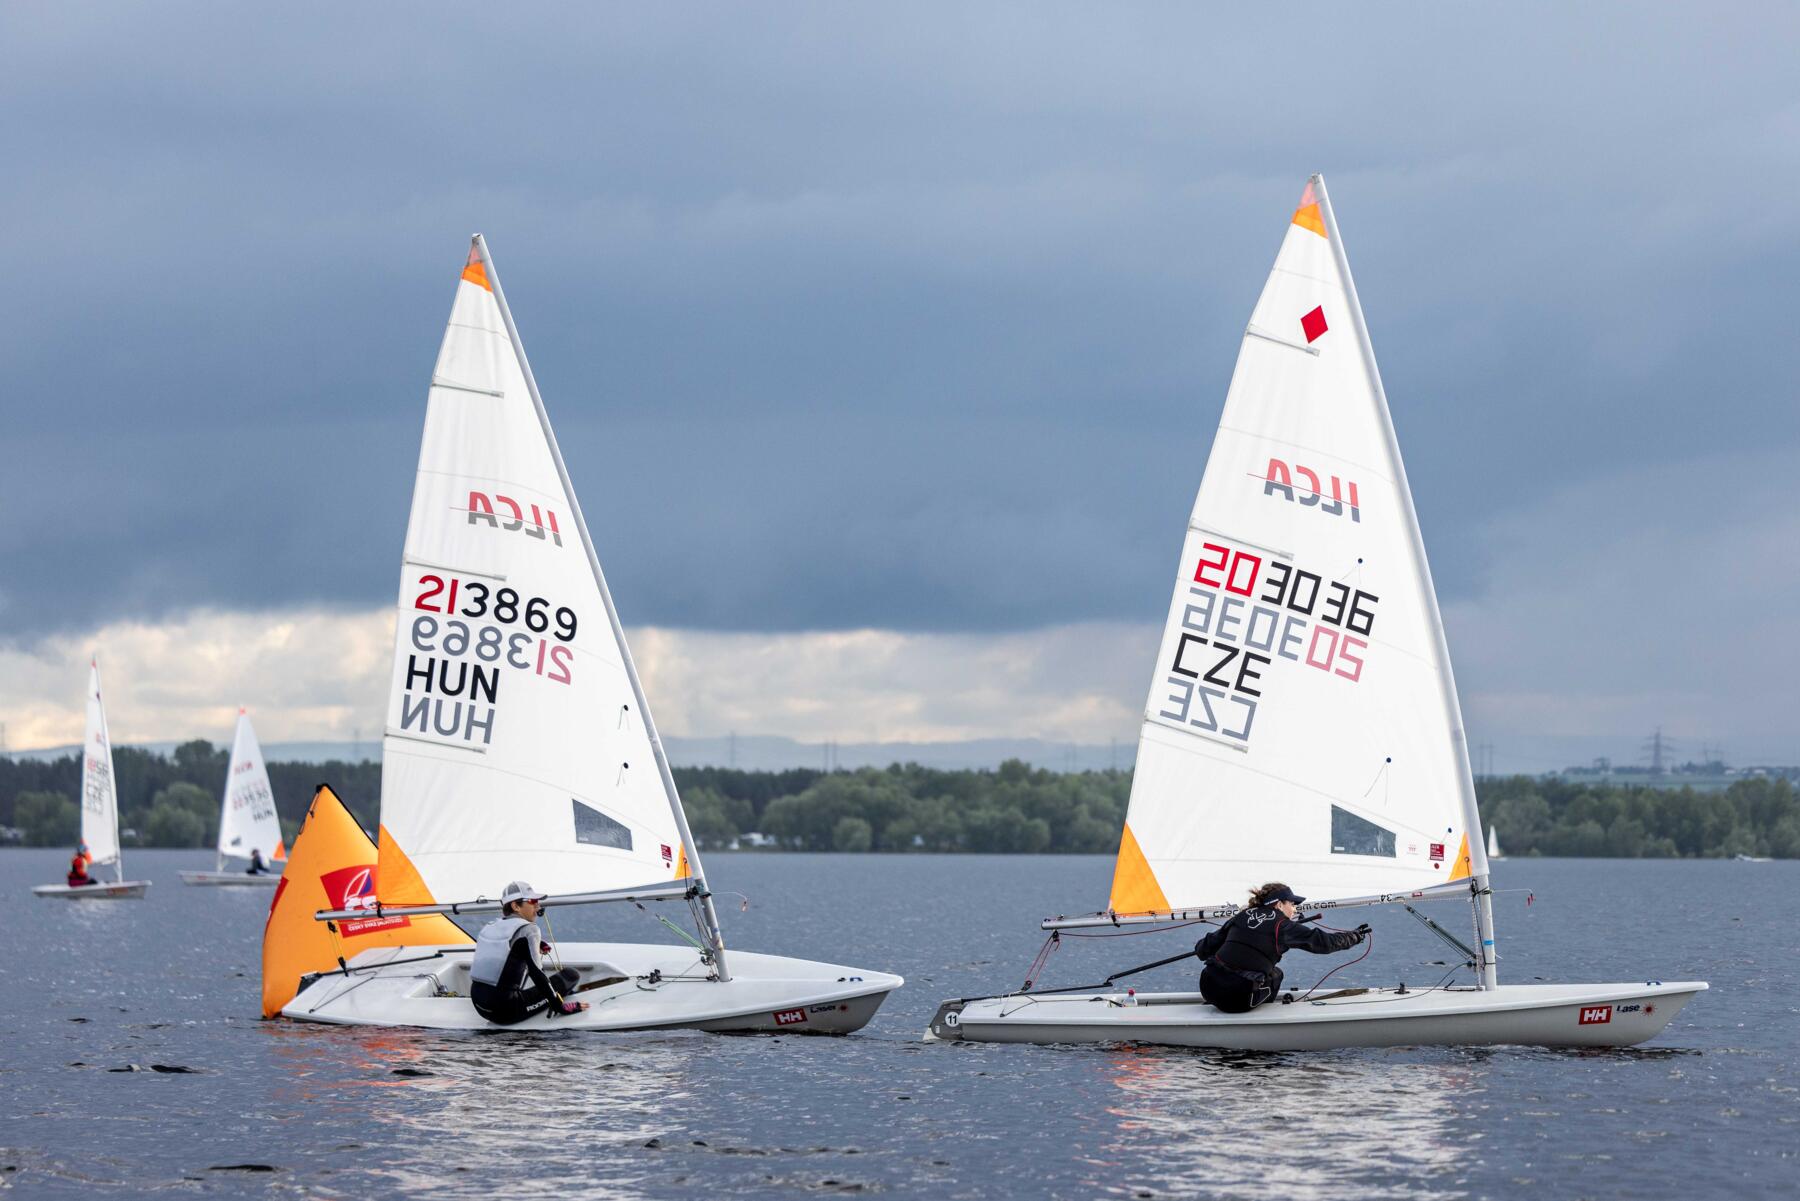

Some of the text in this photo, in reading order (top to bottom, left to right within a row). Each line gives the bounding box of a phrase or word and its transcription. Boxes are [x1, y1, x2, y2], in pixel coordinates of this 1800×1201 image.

[415, 575, 577, 642] 213869
[1193, 542, 1379, 636] 203036
[405, 654, 499, 704] HUN
[1171, 632, 1271, 697] CZE
[948, 1015, 957, 1024] 11
